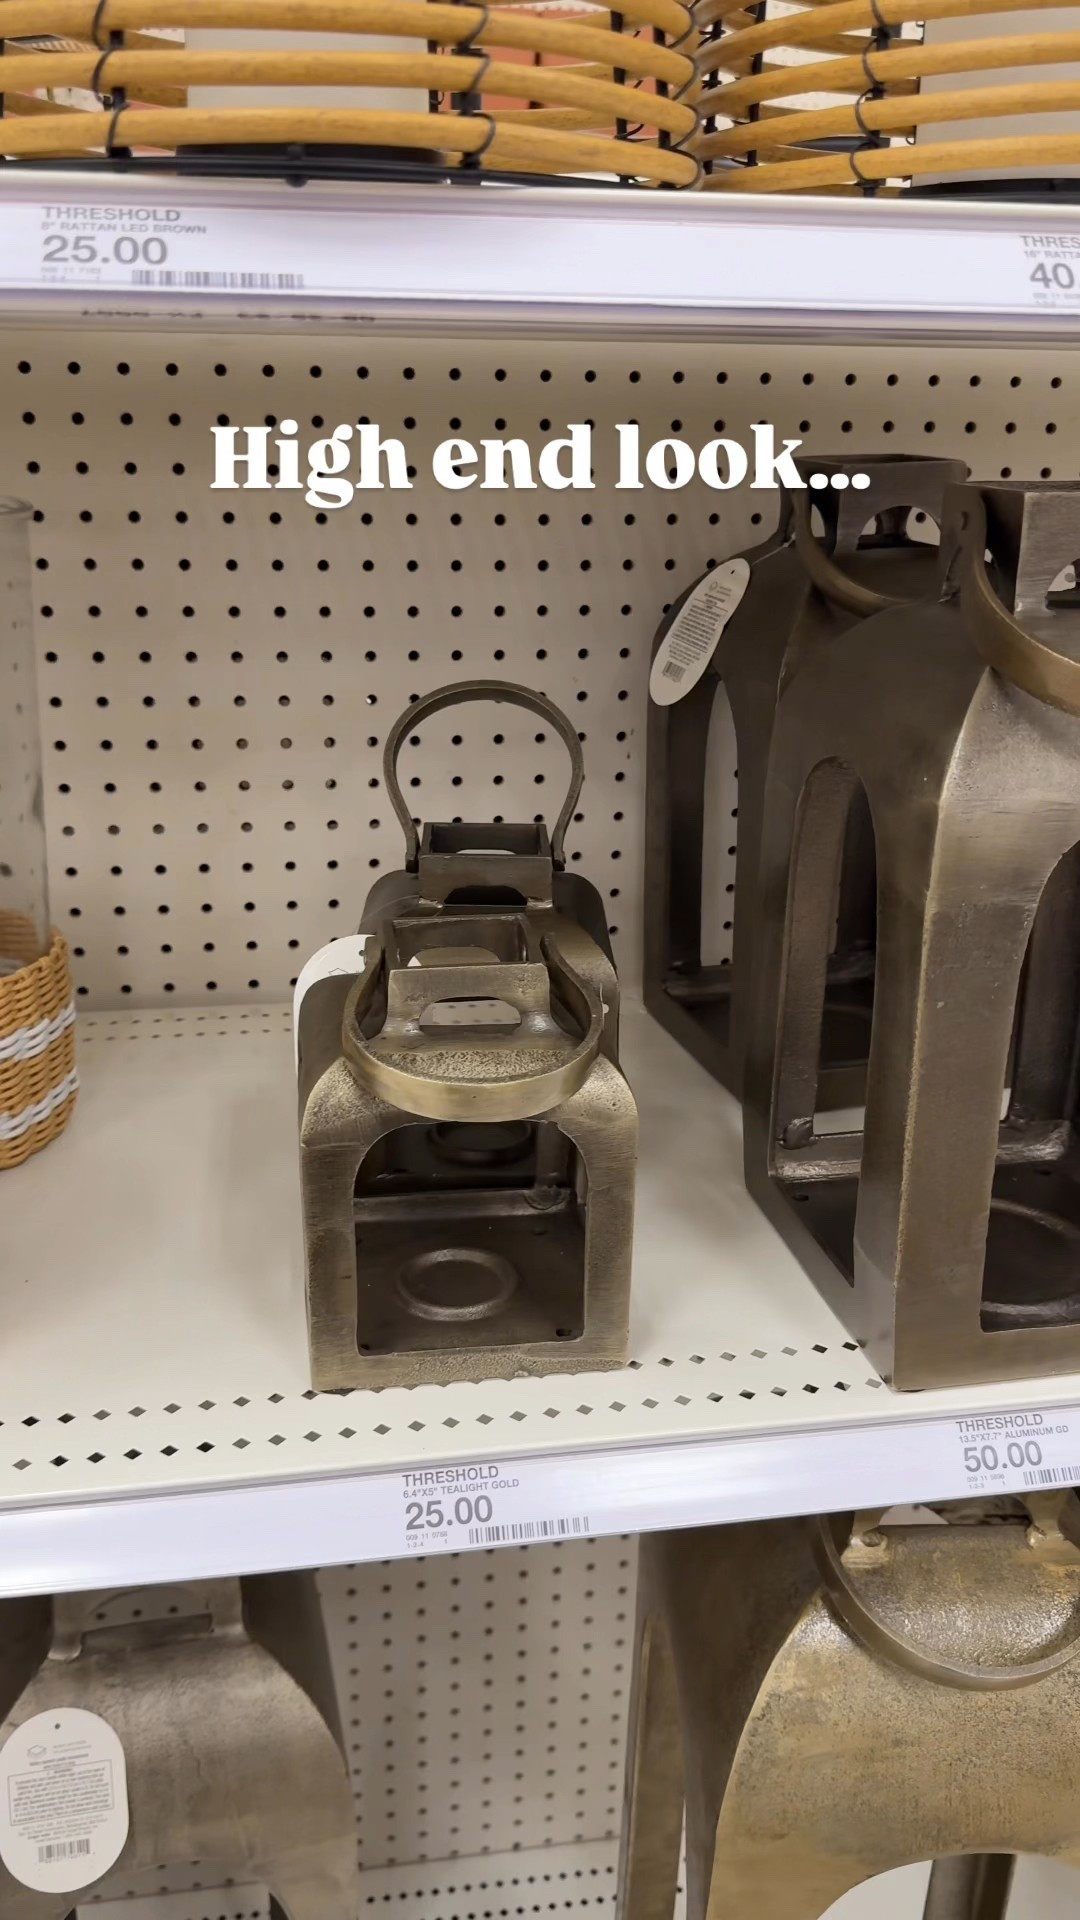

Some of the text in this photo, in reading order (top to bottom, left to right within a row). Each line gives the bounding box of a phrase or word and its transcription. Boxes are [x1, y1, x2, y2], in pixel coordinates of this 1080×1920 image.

[41, 206, 181, 222] THRESHOLD
[60, 222, 117, 232] RATTAN
[121, 223, 149, 233] LED
[153, 224, 207, 234] BROWN
[42, 234, 168, 265] 25.00
[1019, 235, 1080, 249] THRES
[1029, 262, 1080, 290] 40
[956, 1414, 1043, 1433] THRESHOLD
[1005, 1427, 1053, 1439] ALUMINUM
[1055, 1425, 1069, 1434] GD
[963, 1440, 1043, 1472] 50.00
[401, 1465, 499, 1487] THRESHOLD
[441, 1481, 489, 1495] TEALIGHT
[491, 1479, 519, 1489] GOLD
[405, 1495, 493, 1531] 25.00
